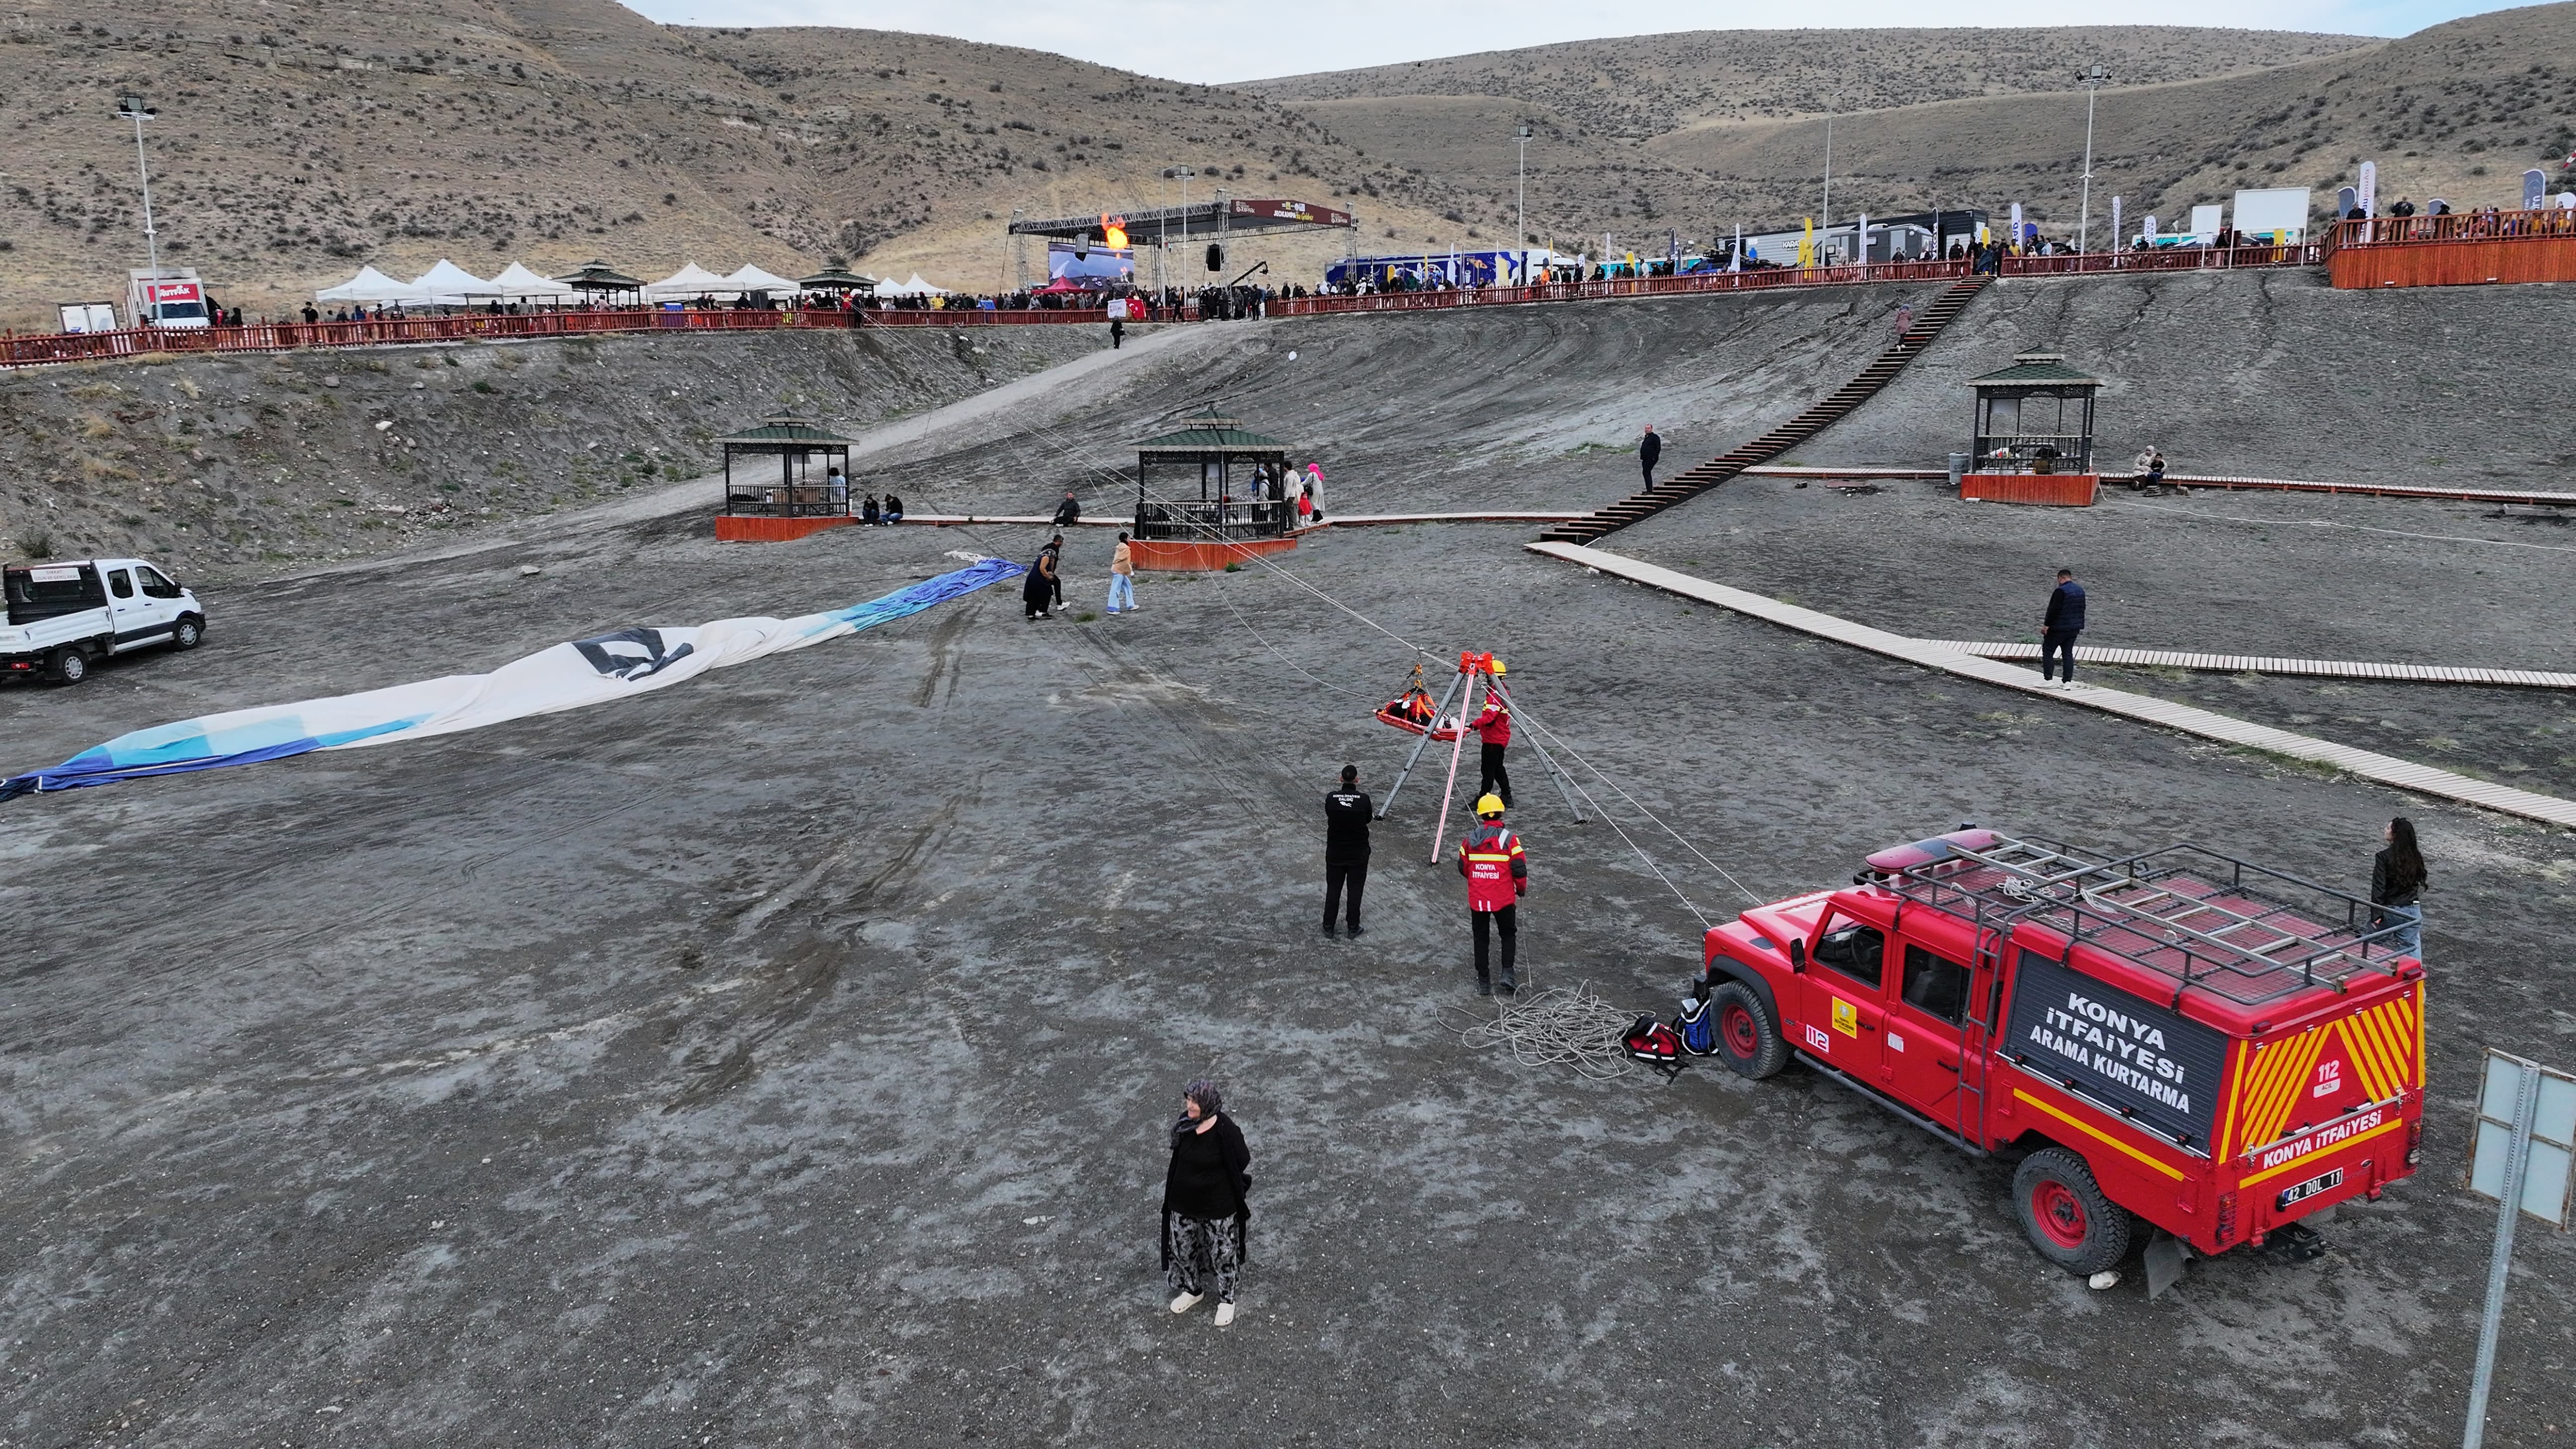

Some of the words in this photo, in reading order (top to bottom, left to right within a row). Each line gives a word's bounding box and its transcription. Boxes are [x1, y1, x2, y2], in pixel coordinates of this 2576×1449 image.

[2068, 992, 2165, 1051] KONYA
[1808, 1027, 1827, 1050] 112
[2030, 1025, 2088, 1066] ARAMA
[2093, 1054, 2189, 1114] KURTARMA
[2318, 1060, 2340, 1082] 112
[2264, 1138, 2312, 1169] KONYA
[2288, 1187, 2300, 1201] 42
[2306, 1179, 2322, 1195] DOL
[2330, 1171, 2341, 1185] 11
